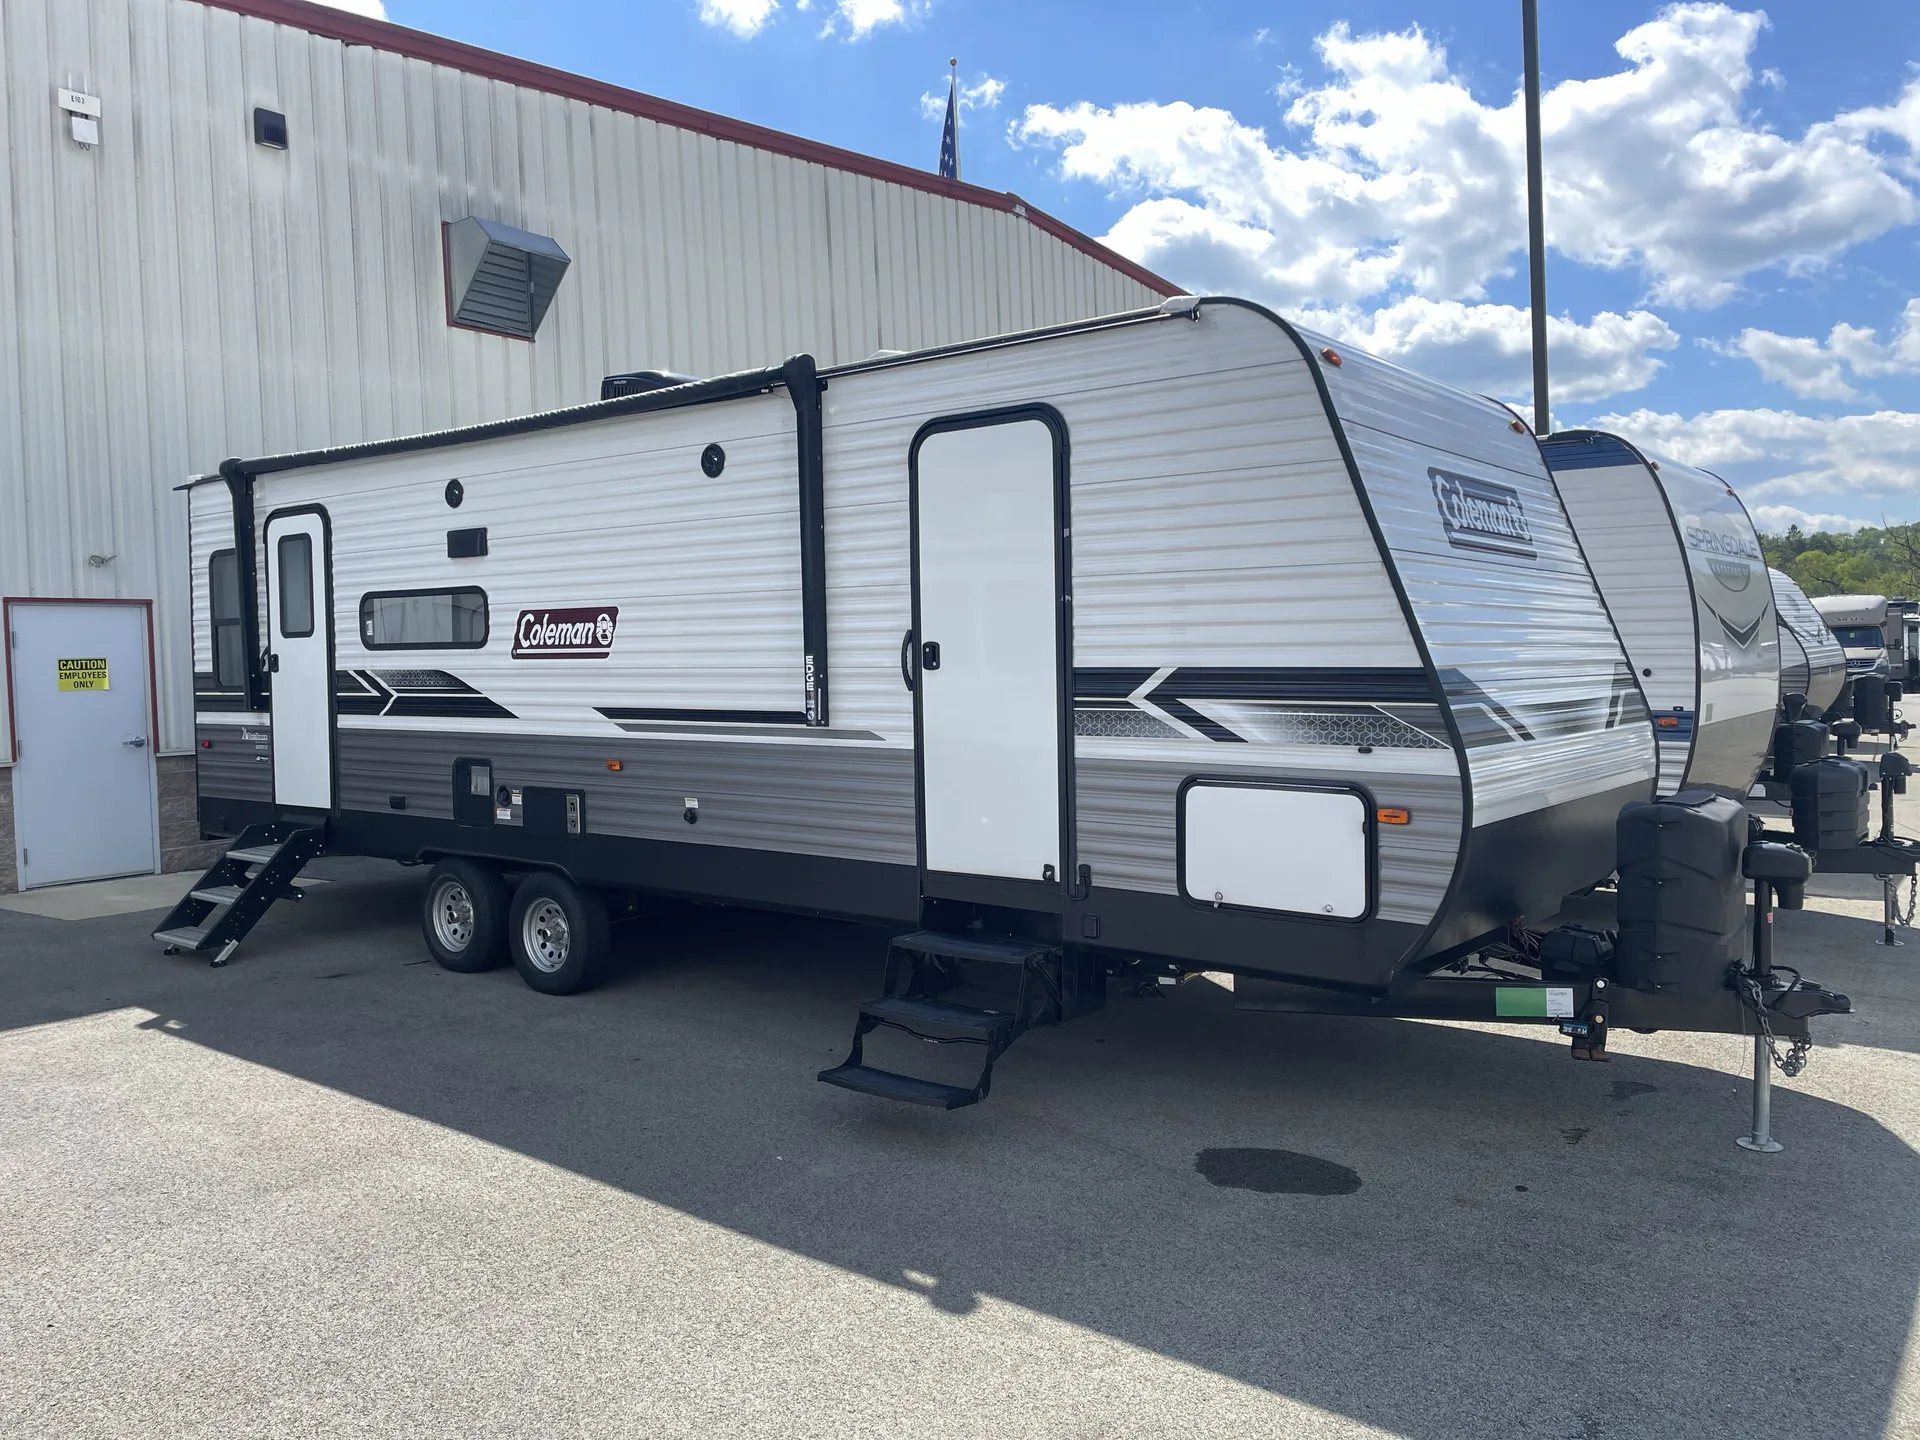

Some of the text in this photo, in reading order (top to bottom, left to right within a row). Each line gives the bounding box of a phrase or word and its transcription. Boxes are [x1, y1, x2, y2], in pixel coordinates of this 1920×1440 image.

[1435, 475, 1517, 537] Coleman
[1686, 526, 1760, 559] SPRINGDALE
[519, 613, 595, 648] Coleman
[59, 671, 107, 680] EMPLOYEES
[60, 660, 105, 670] CAUTION
[805, 655, 815, 691] EDGE
[73, 680, 94, 689] ONLY
